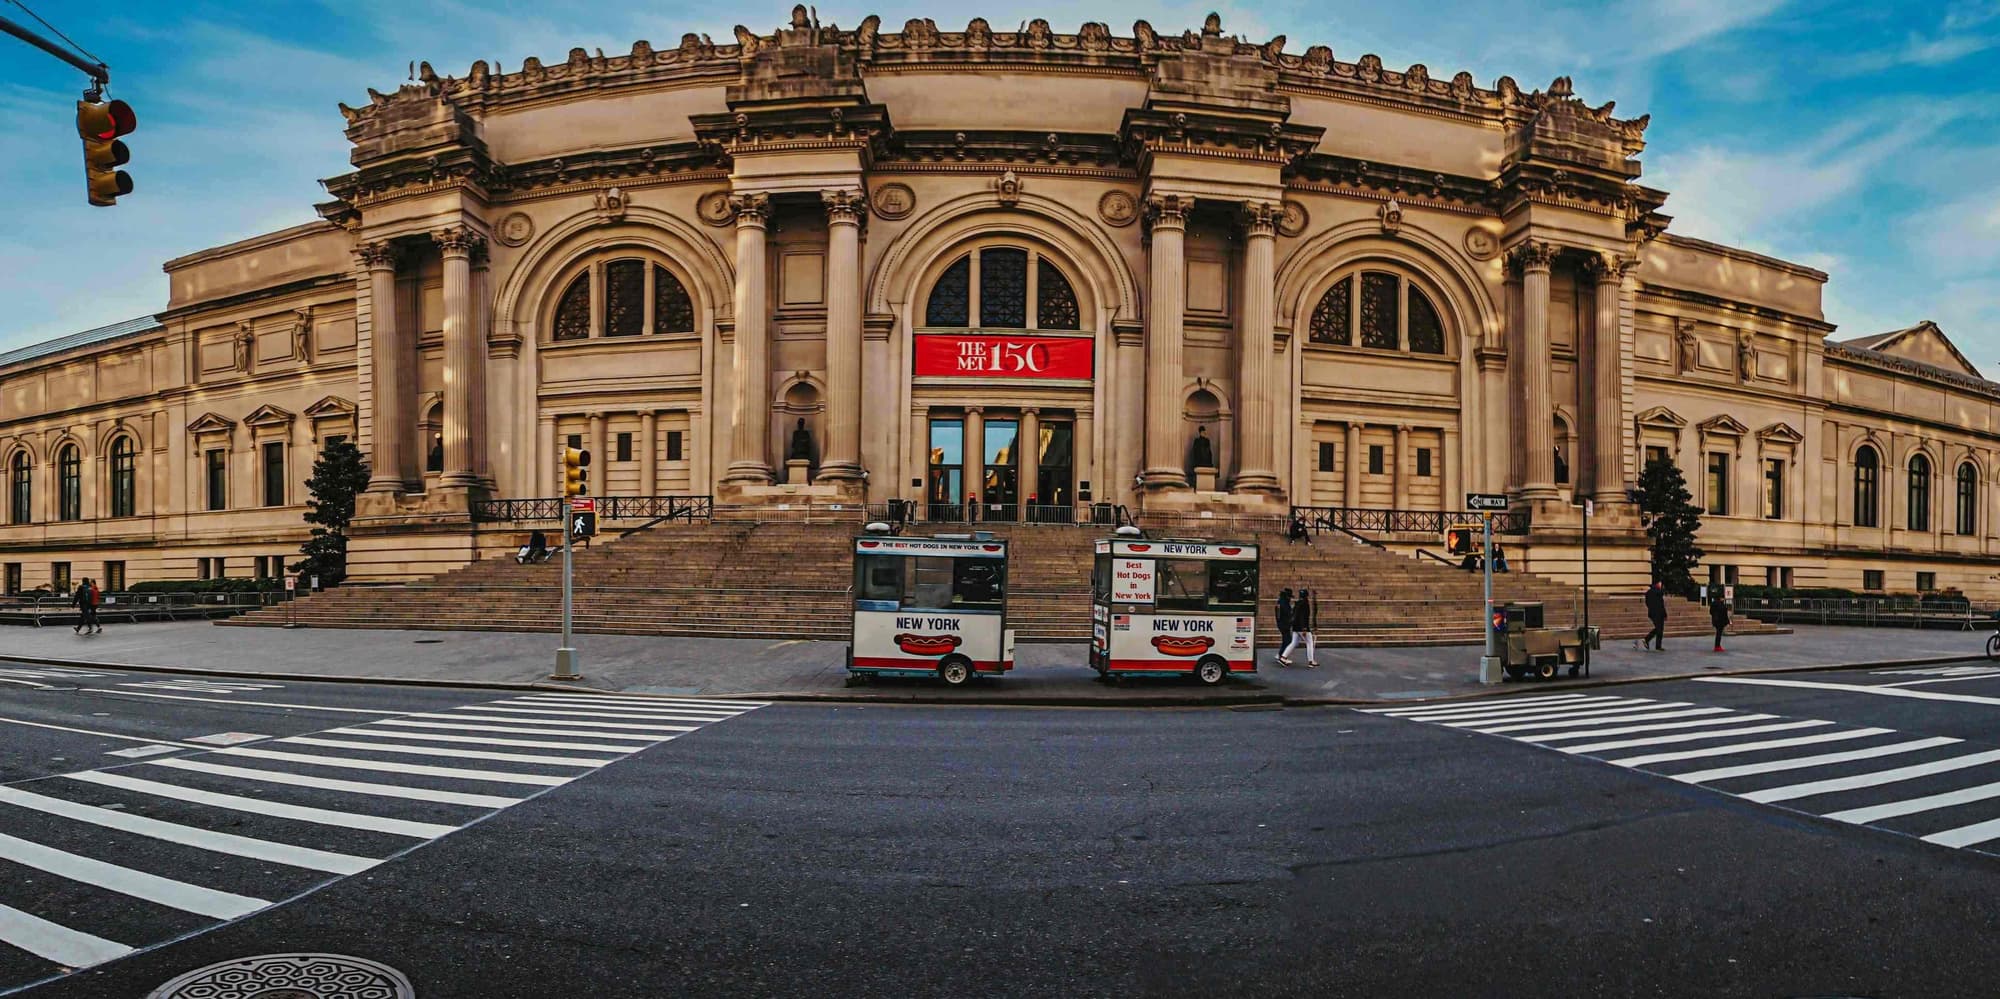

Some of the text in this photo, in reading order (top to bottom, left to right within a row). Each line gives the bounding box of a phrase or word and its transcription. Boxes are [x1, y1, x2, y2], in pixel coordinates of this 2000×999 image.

[957, 341, 986, 356] THE
[988, 342, 1050, 372] 150
[956, 357, 987, 371] MET
[1472, 498, 1503, 506] ONE WAY
[1164, 544, 1207, 555] NEW YORK
[1126, 561, 1142, 569] Best
[1116, 571, 1151, 580] Hot Dogs
[1134, 592, 1152, 600] York
[896, 617, 960, 631] NEW YORK
[1153, 619, 1214, 632] NEW YORK
